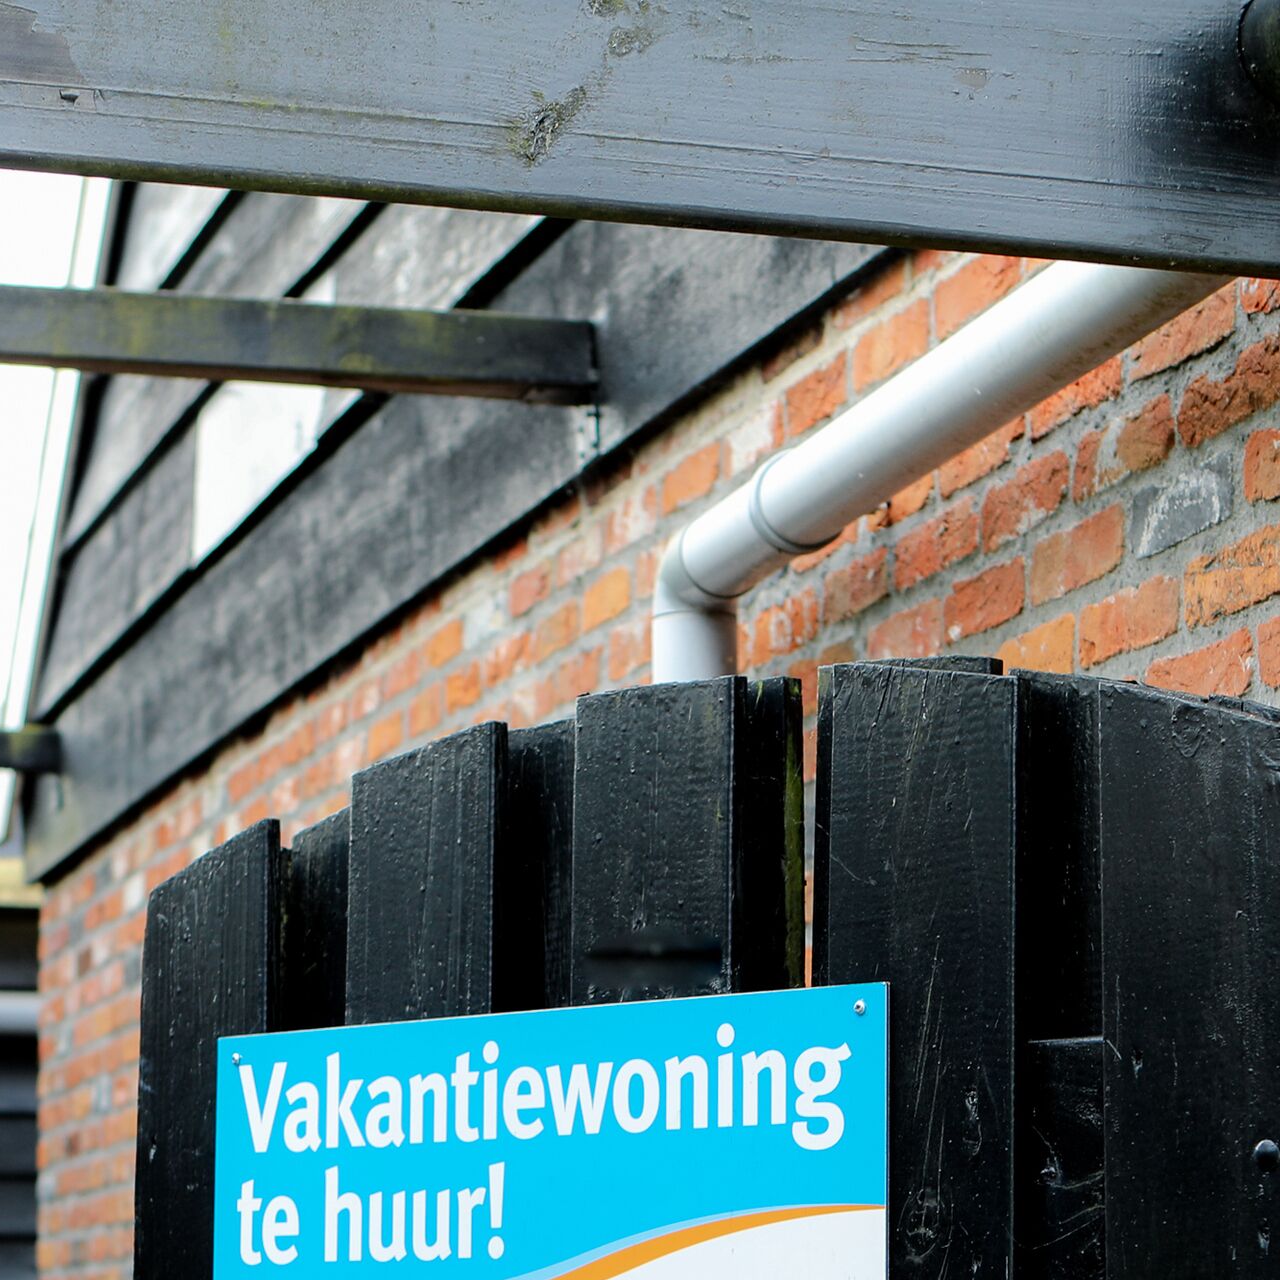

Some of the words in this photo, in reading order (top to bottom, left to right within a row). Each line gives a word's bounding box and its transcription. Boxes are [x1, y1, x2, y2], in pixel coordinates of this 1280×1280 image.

[239, 1022, 852, 1153] Vakantiewoning
[236, 1178, 301, 1266] te
[323, 1161, 506, 1263] huur!
